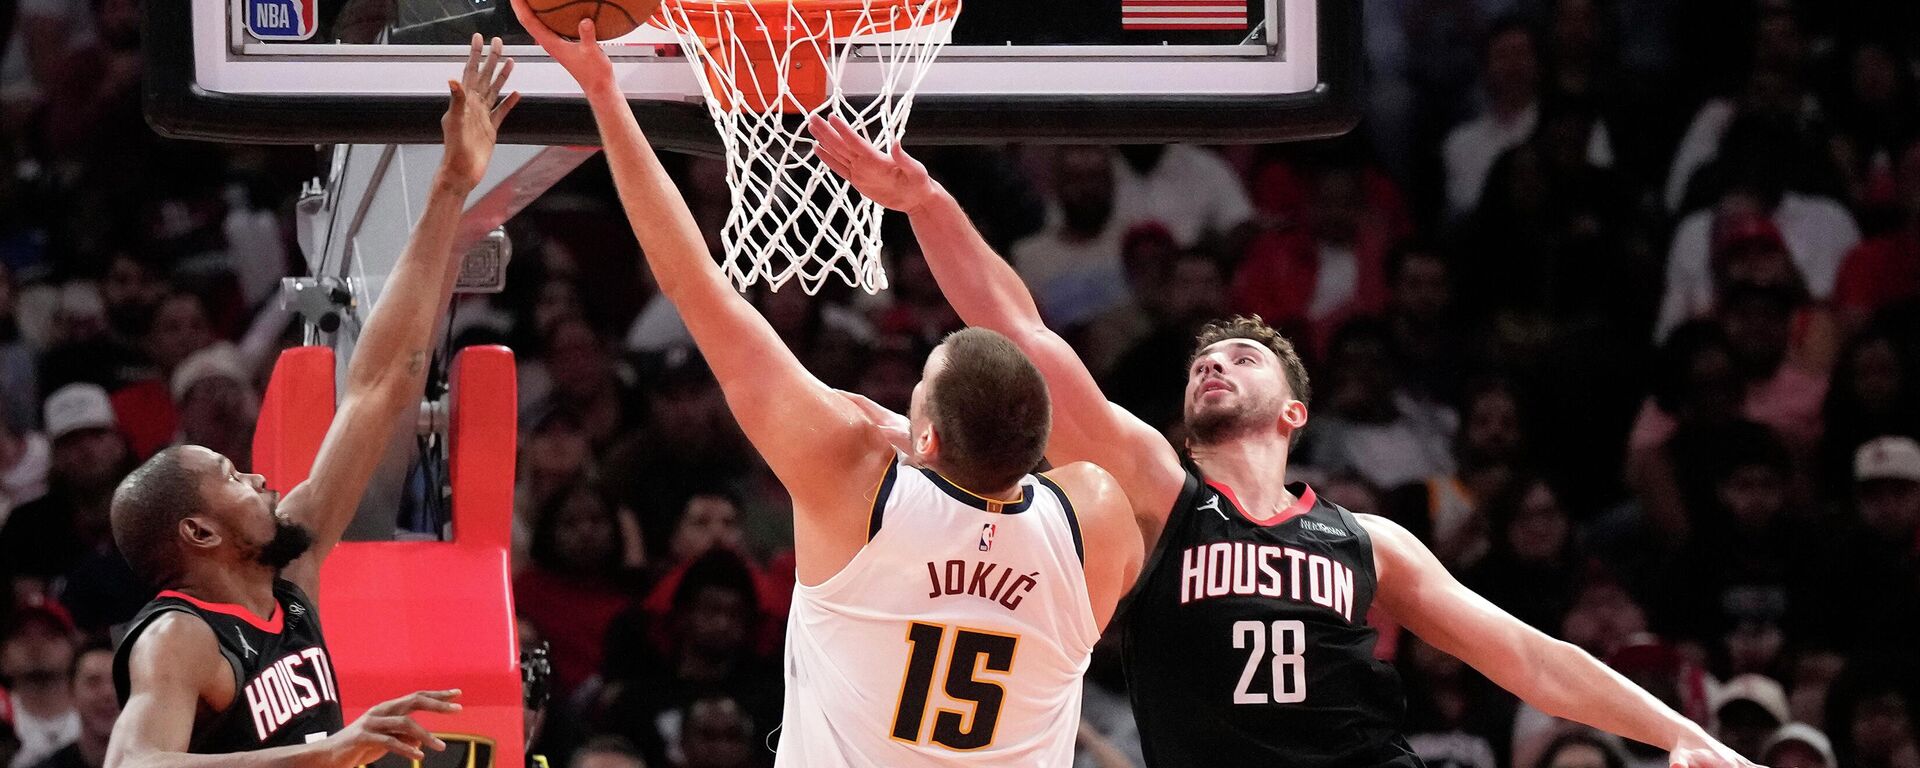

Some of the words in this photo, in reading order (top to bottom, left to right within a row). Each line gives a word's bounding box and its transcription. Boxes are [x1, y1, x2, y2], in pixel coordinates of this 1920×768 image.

[256, 3, 291, 29] NBA
[926, 559, 1041, 611] JOKIĆ
[1180, 541, 1355, 624] HOUSTON
[889, 620, 1022, 753] 15
[1232, 619, 1307, 705] 28
